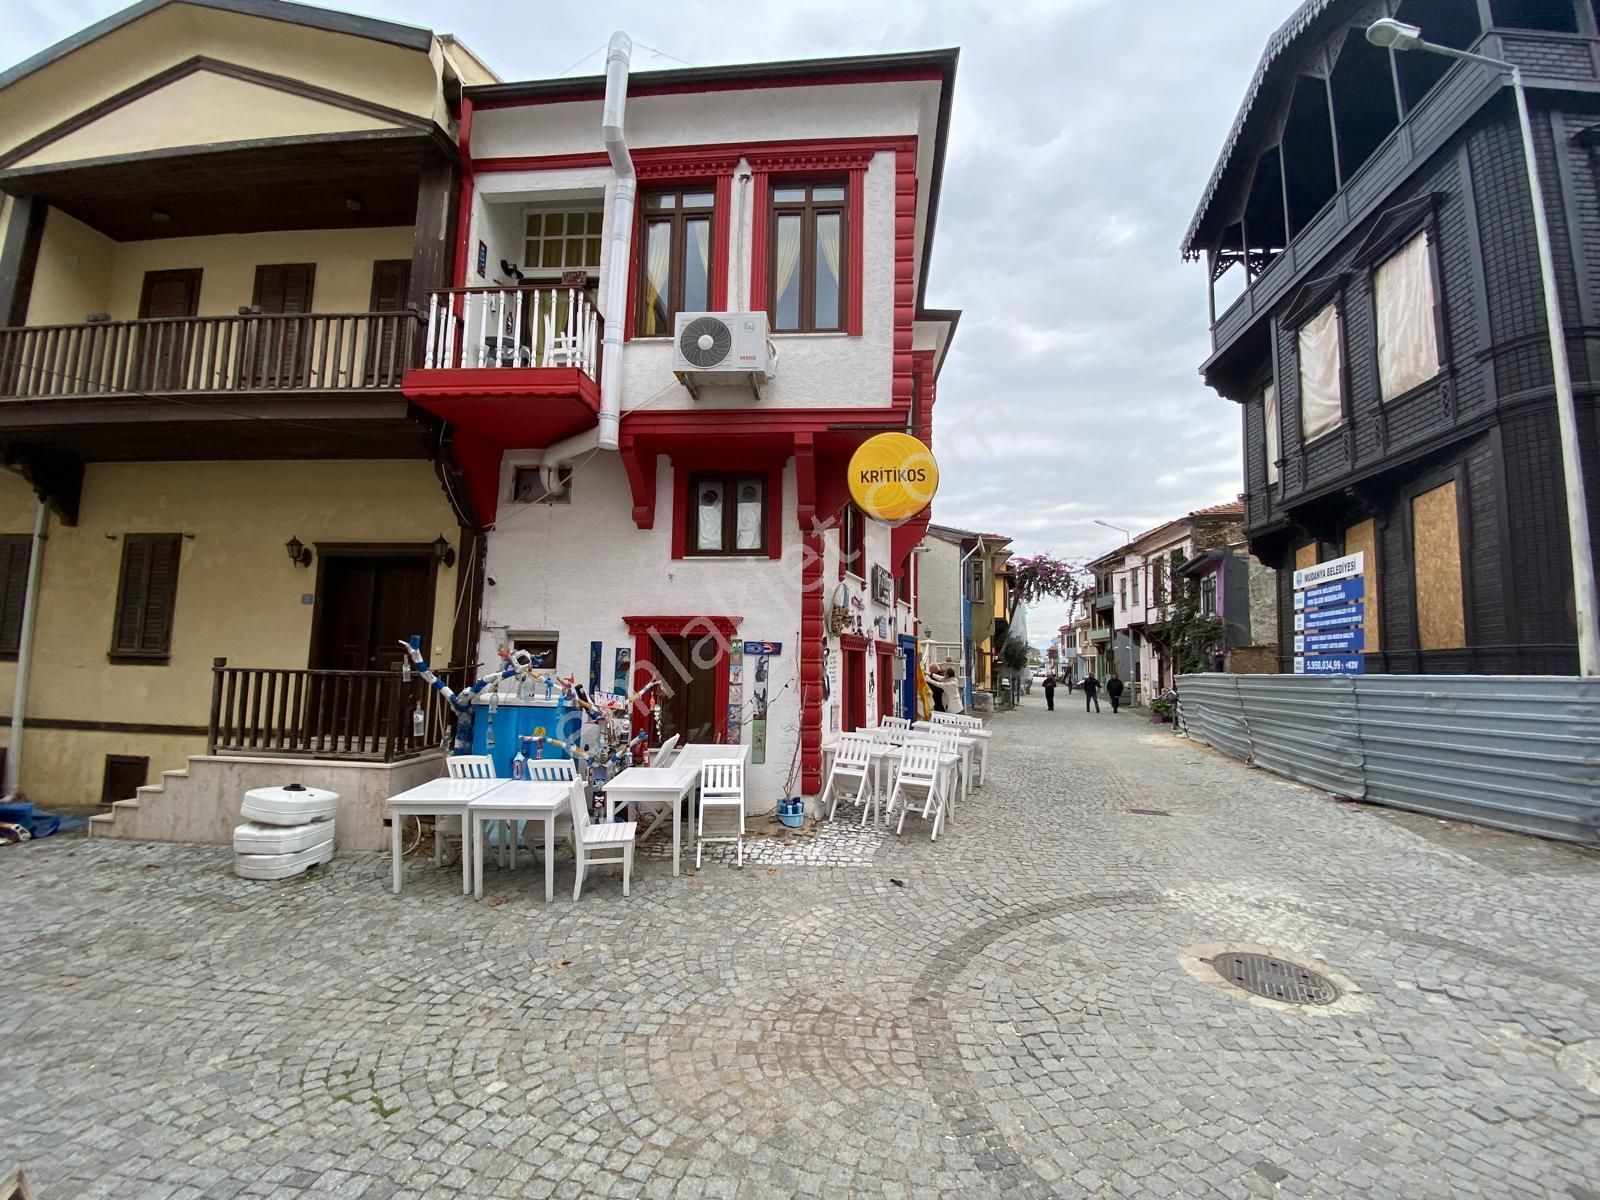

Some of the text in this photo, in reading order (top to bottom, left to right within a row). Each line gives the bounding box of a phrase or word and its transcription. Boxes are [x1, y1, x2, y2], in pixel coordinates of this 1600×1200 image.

[860, 467, 926, 483] KRİTİKOS
[1304, 559, 1356, 582] MUDANYA BELEDİYESİ
